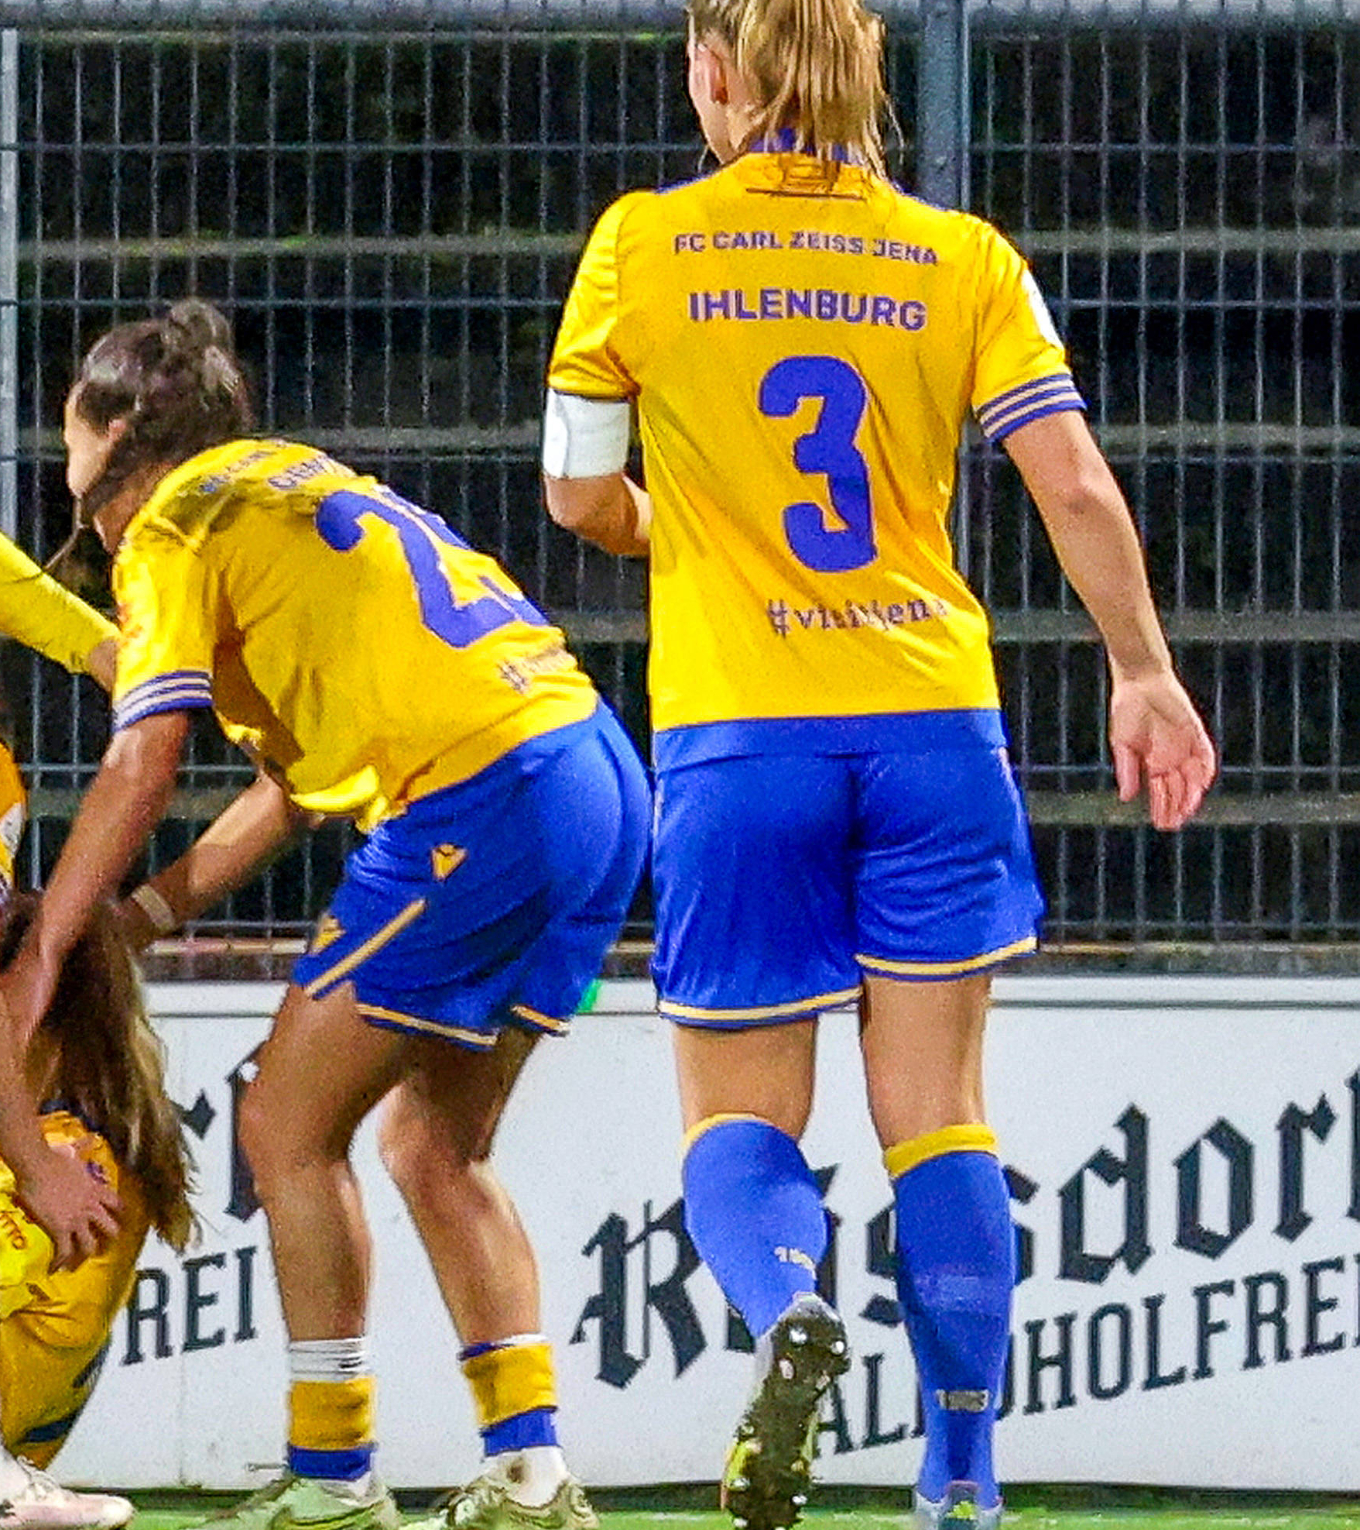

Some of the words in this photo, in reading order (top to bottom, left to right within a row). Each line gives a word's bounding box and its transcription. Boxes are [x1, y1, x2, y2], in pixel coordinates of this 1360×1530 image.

[674, 233, 706, 255] FC
[712, 230, 783, 250] CARL
[789, 231, 864, 256] ZEISS
[872, 238, 938, 266] JENA
[689, 286, 927, 332] IHLENBURG
[758, 355, 878, 574] 3
